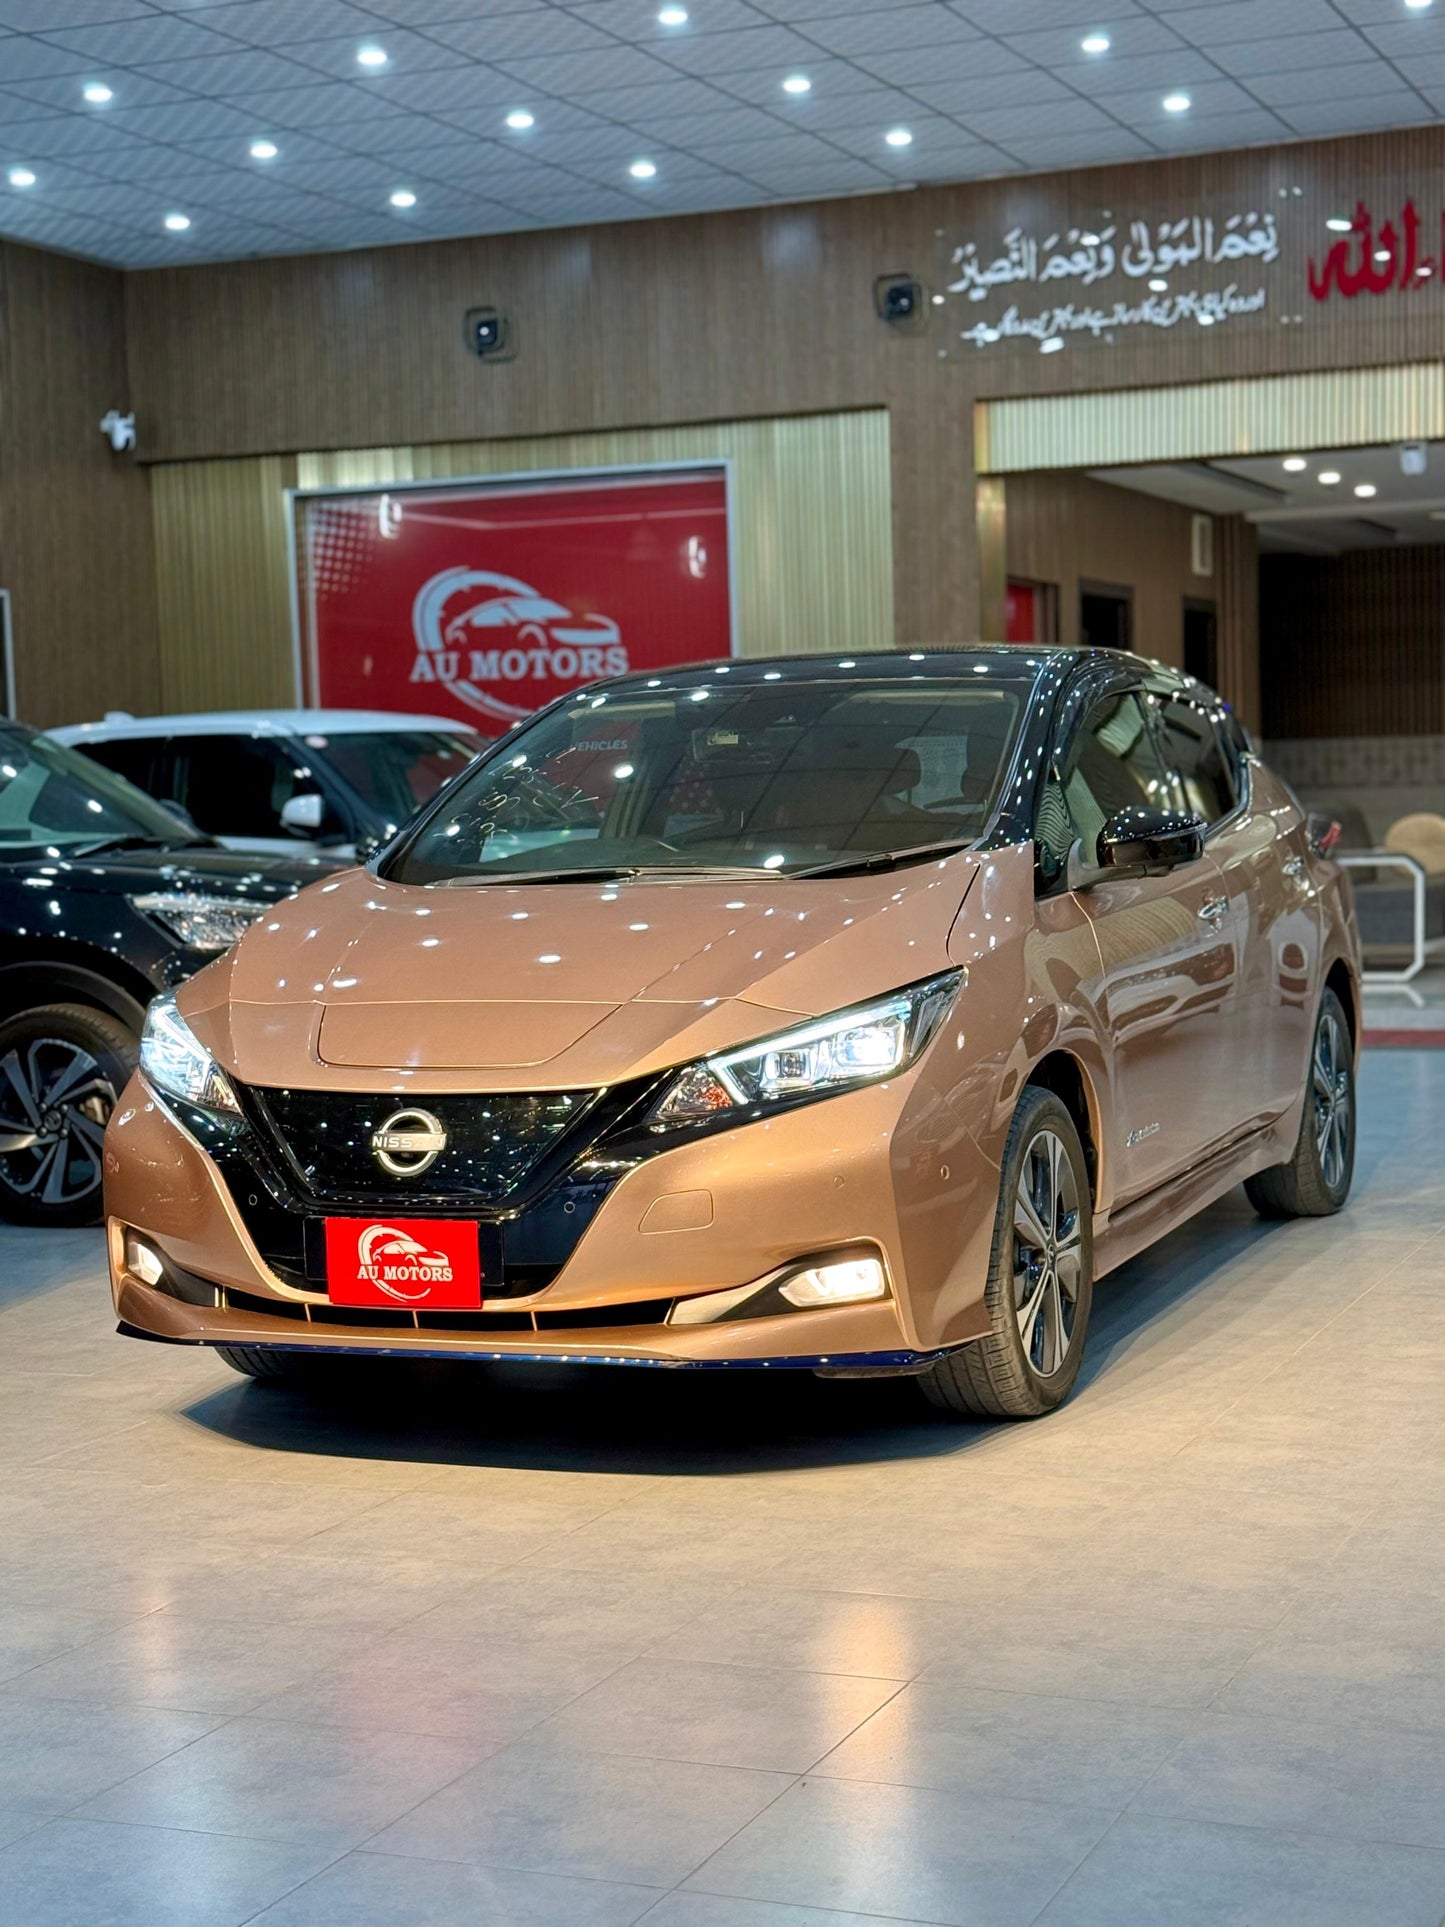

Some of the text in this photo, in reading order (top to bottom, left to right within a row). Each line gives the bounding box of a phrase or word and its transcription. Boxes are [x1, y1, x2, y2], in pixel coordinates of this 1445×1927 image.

[409, 646, 630, 683] AU MOTORS
[357, 1265, 453, 1282] AU MOTORS
